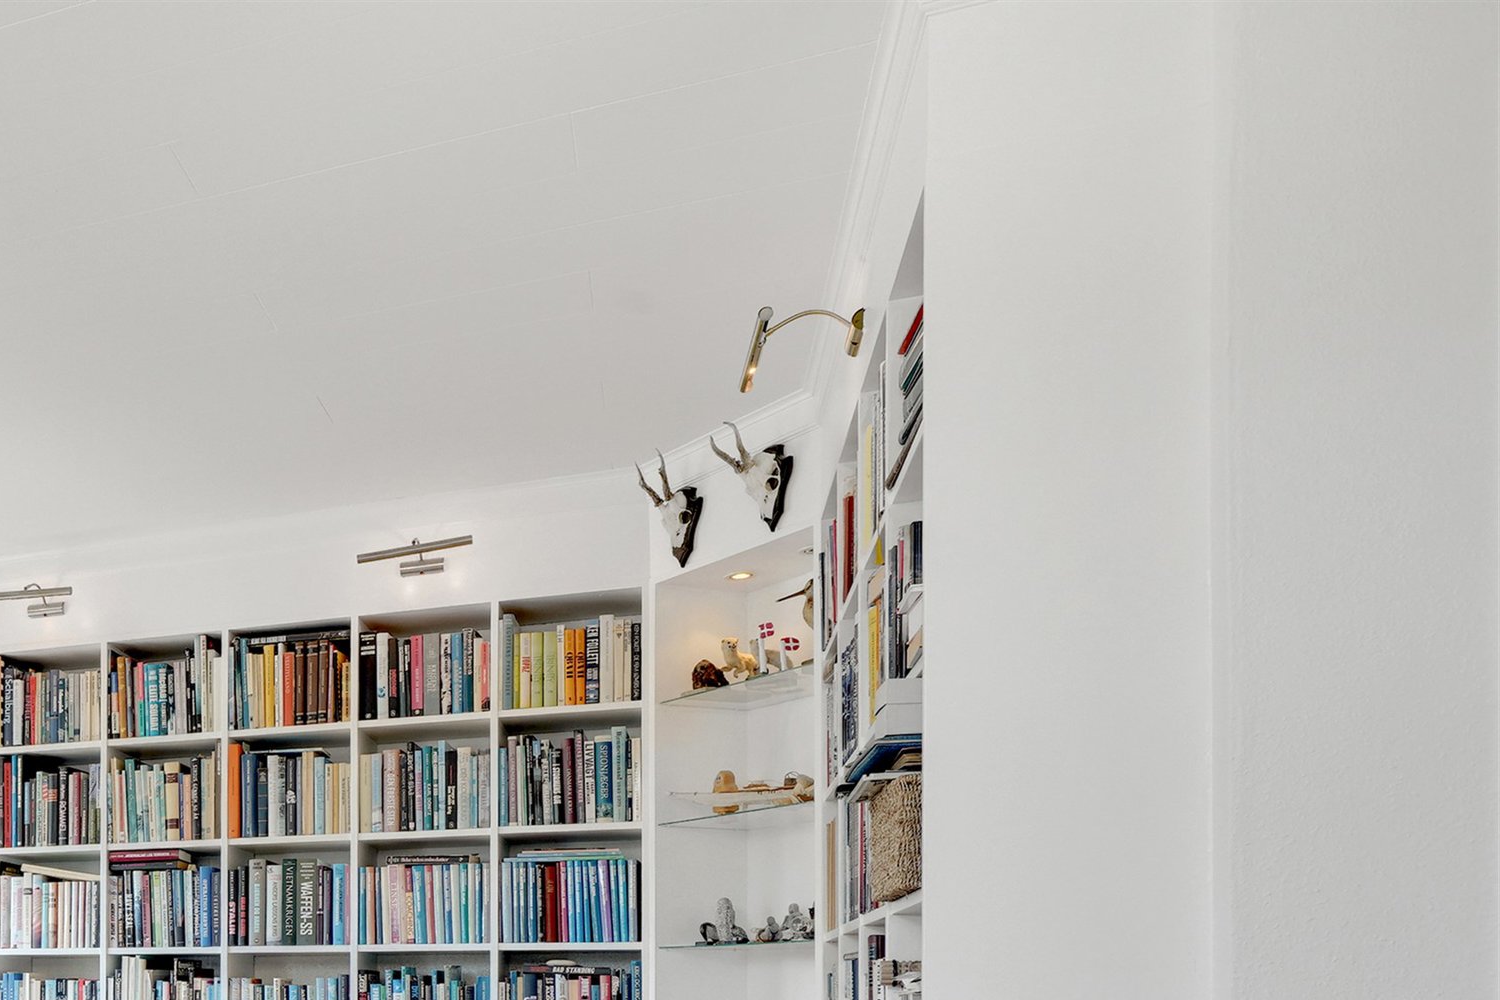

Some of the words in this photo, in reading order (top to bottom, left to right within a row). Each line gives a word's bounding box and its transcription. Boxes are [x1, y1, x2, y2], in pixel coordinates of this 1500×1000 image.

[586, 640, 599, 665] FOLLETT
[585, 743, 595, 779] LIVVAGT
[599, 745, 609, 799] SPIONJÆGER
[58, 801, 67, 831] ROMMEL
[228, 901, 236, 935] STALIN
[285, 866, 294, 936] VIETNAMKRIGEN
[299, 881, 313, 935] WAFFEN-SS
